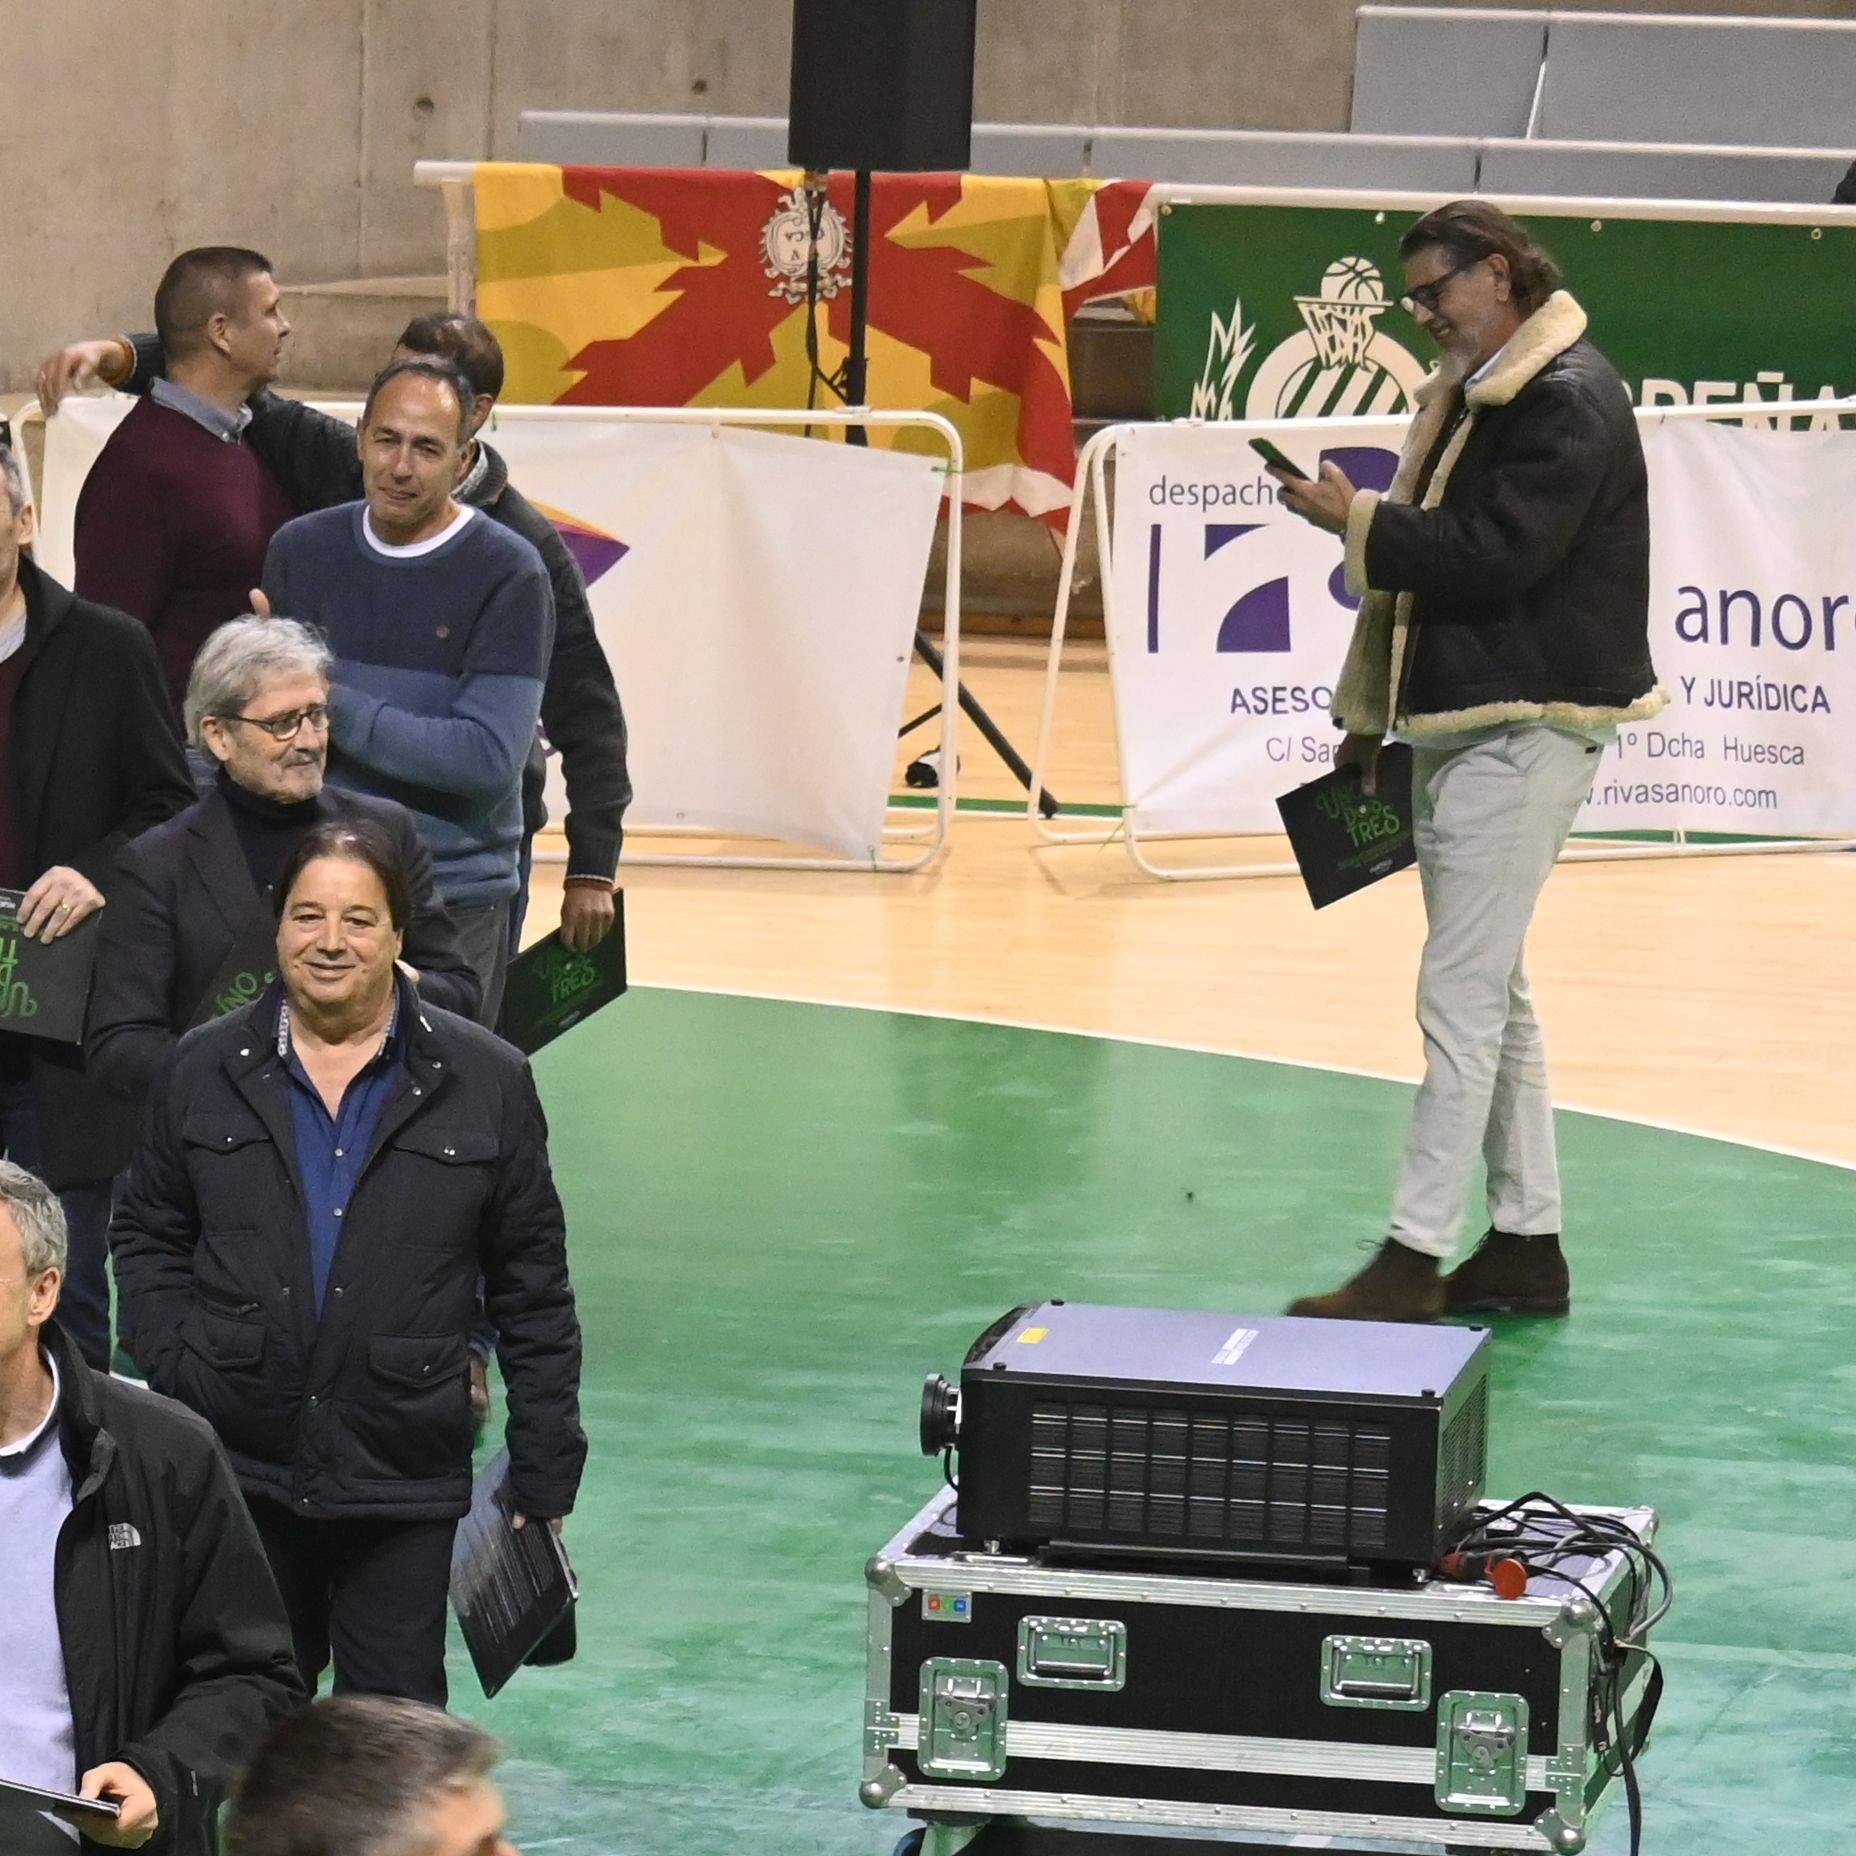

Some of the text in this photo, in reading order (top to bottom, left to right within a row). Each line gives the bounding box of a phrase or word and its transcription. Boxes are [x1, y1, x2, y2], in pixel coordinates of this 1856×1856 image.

[1675, 586, 1856, 651] anor
[1231, 686, 1334, 715] ASESO
[1681, 675, 1831, 714] Y JURÍDICA
[1266, 736, 1291, 762] C/
[1647, 732, 1705, 760] Dcha
[1724, 735, 1805, 766] Huesca
